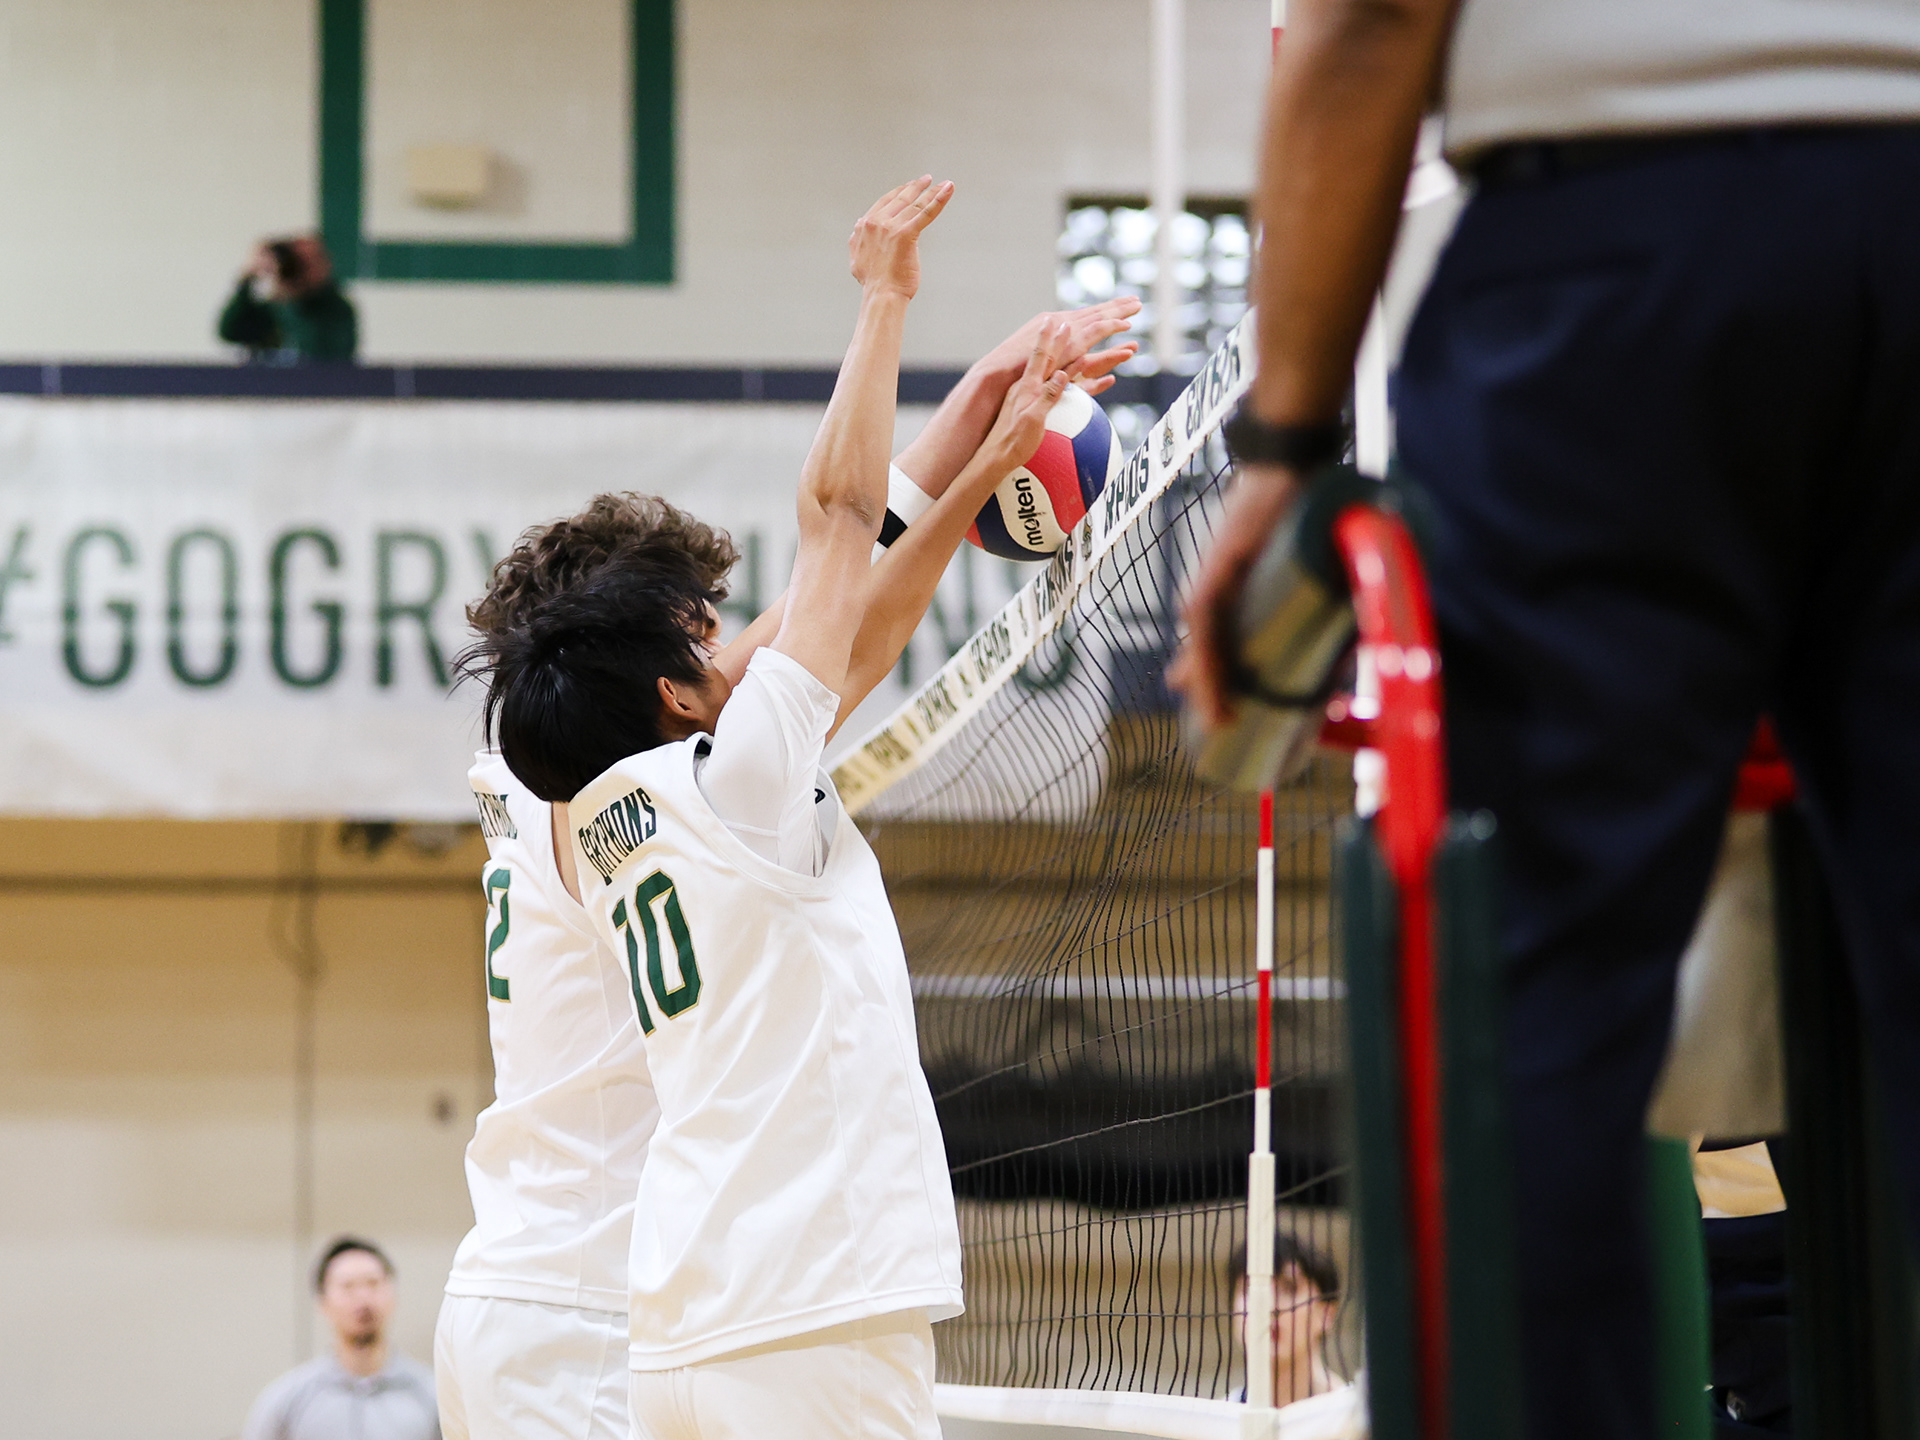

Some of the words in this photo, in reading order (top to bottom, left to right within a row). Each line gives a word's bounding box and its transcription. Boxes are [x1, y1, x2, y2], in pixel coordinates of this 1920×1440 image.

[1014, 477, 1044, 546] molten
[577, 787, 657, 886] GRYPHONS
[612, 867, 704, 1038] 10
